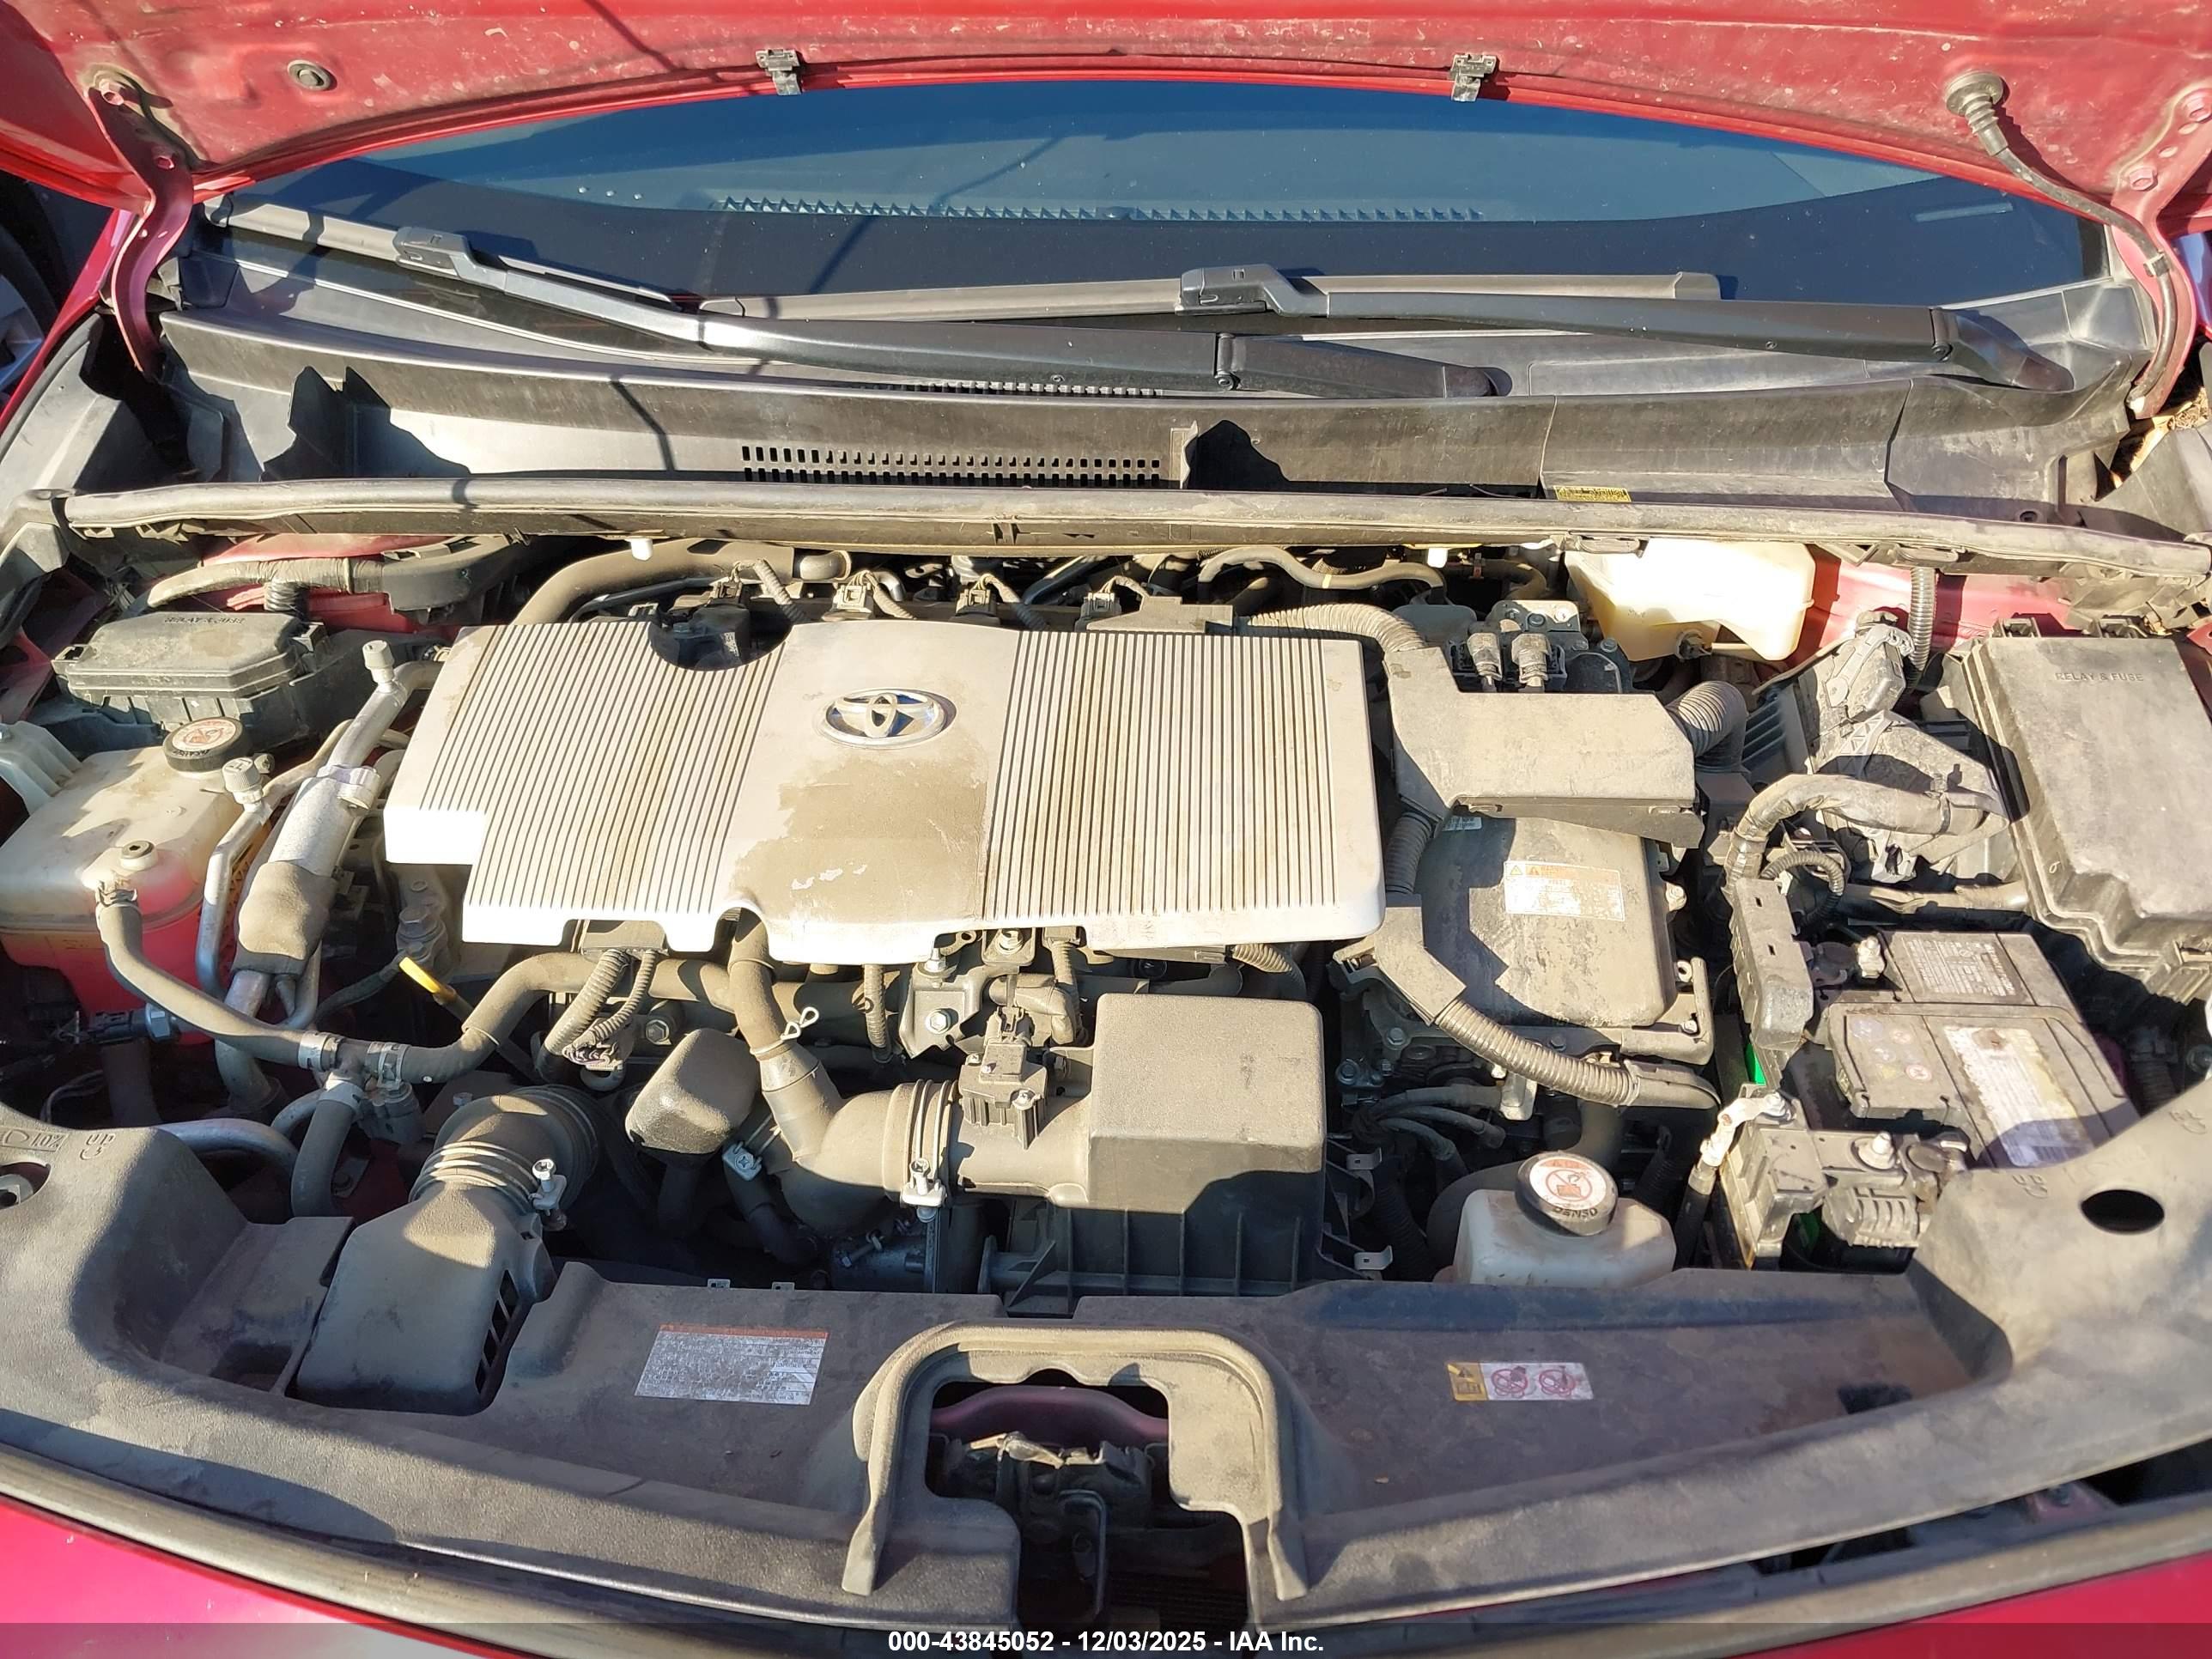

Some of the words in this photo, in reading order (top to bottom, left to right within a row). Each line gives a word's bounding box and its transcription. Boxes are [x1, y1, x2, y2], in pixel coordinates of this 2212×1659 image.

[2054, 672, 2095, 682] RELAY
[2100, 673, 2109, 682] &
[2111, 673, 2144, 682] FUSE
[86, 1133, 116, 1146] UP
[1553, 1206, 1599, 1218] DENSO
